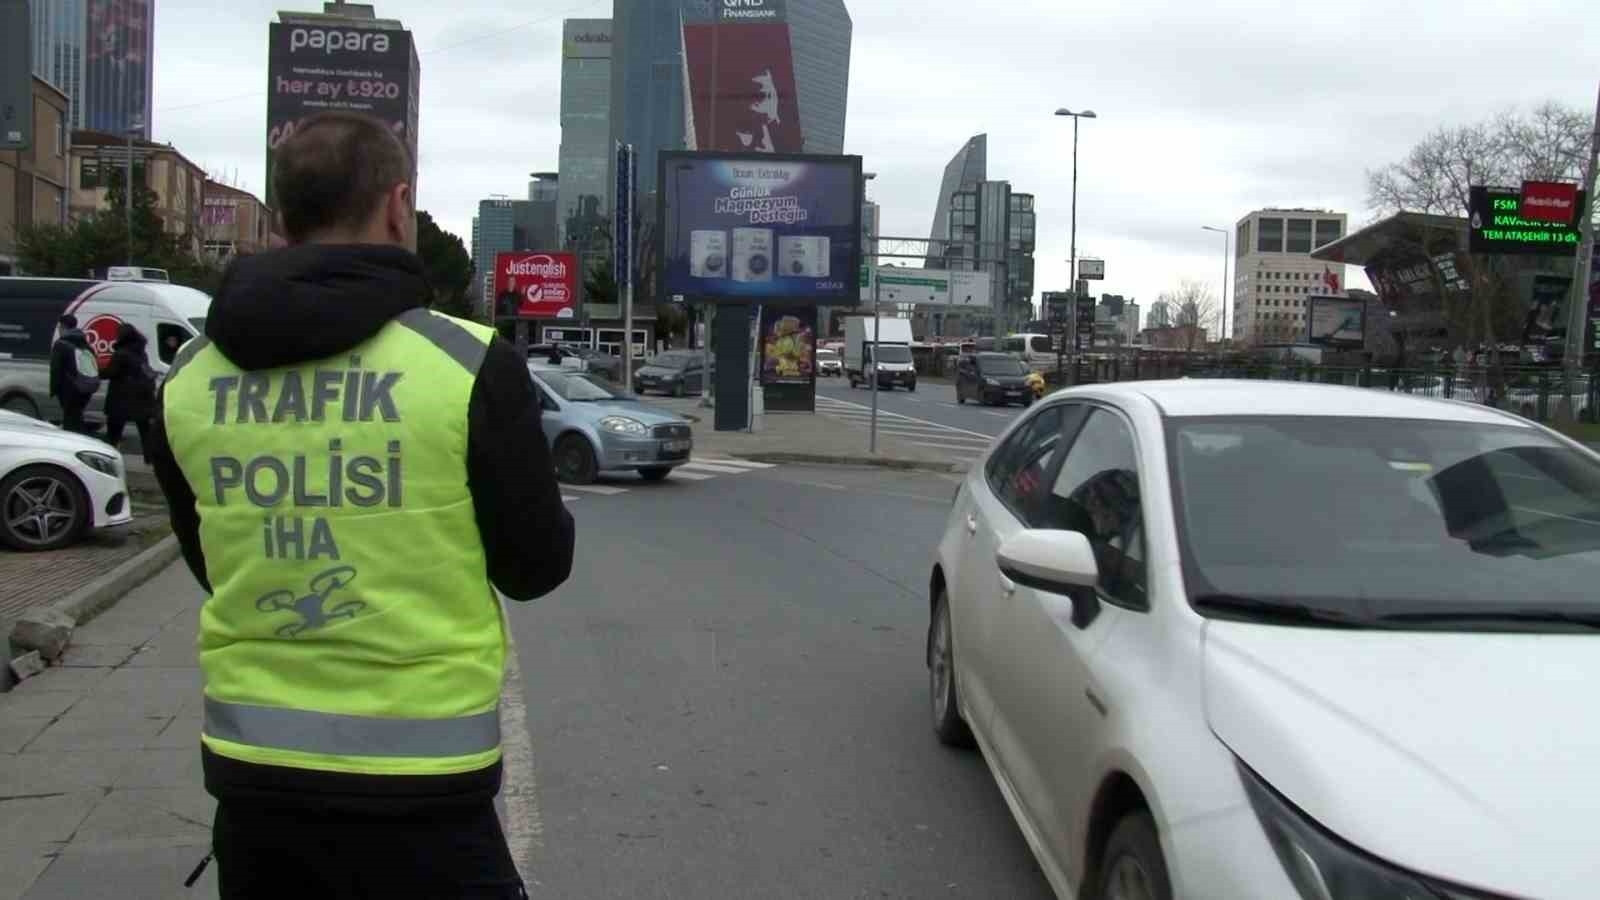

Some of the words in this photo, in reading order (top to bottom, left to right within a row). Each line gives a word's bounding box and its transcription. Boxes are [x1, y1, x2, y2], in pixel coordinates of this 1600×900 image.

[290, 28, 390, 54] papara
[276, 75, 313, 94] her
[317, 83, 342, 99] ay
[1493, 199, 1518, 211] FSM
[1483, 230, 1504, 240] TEM
[1552, 232, 1563, 242] 13
[208, 354, 404, 425] TRAFİK
[209, 437, 403, 509] POLİSİ
